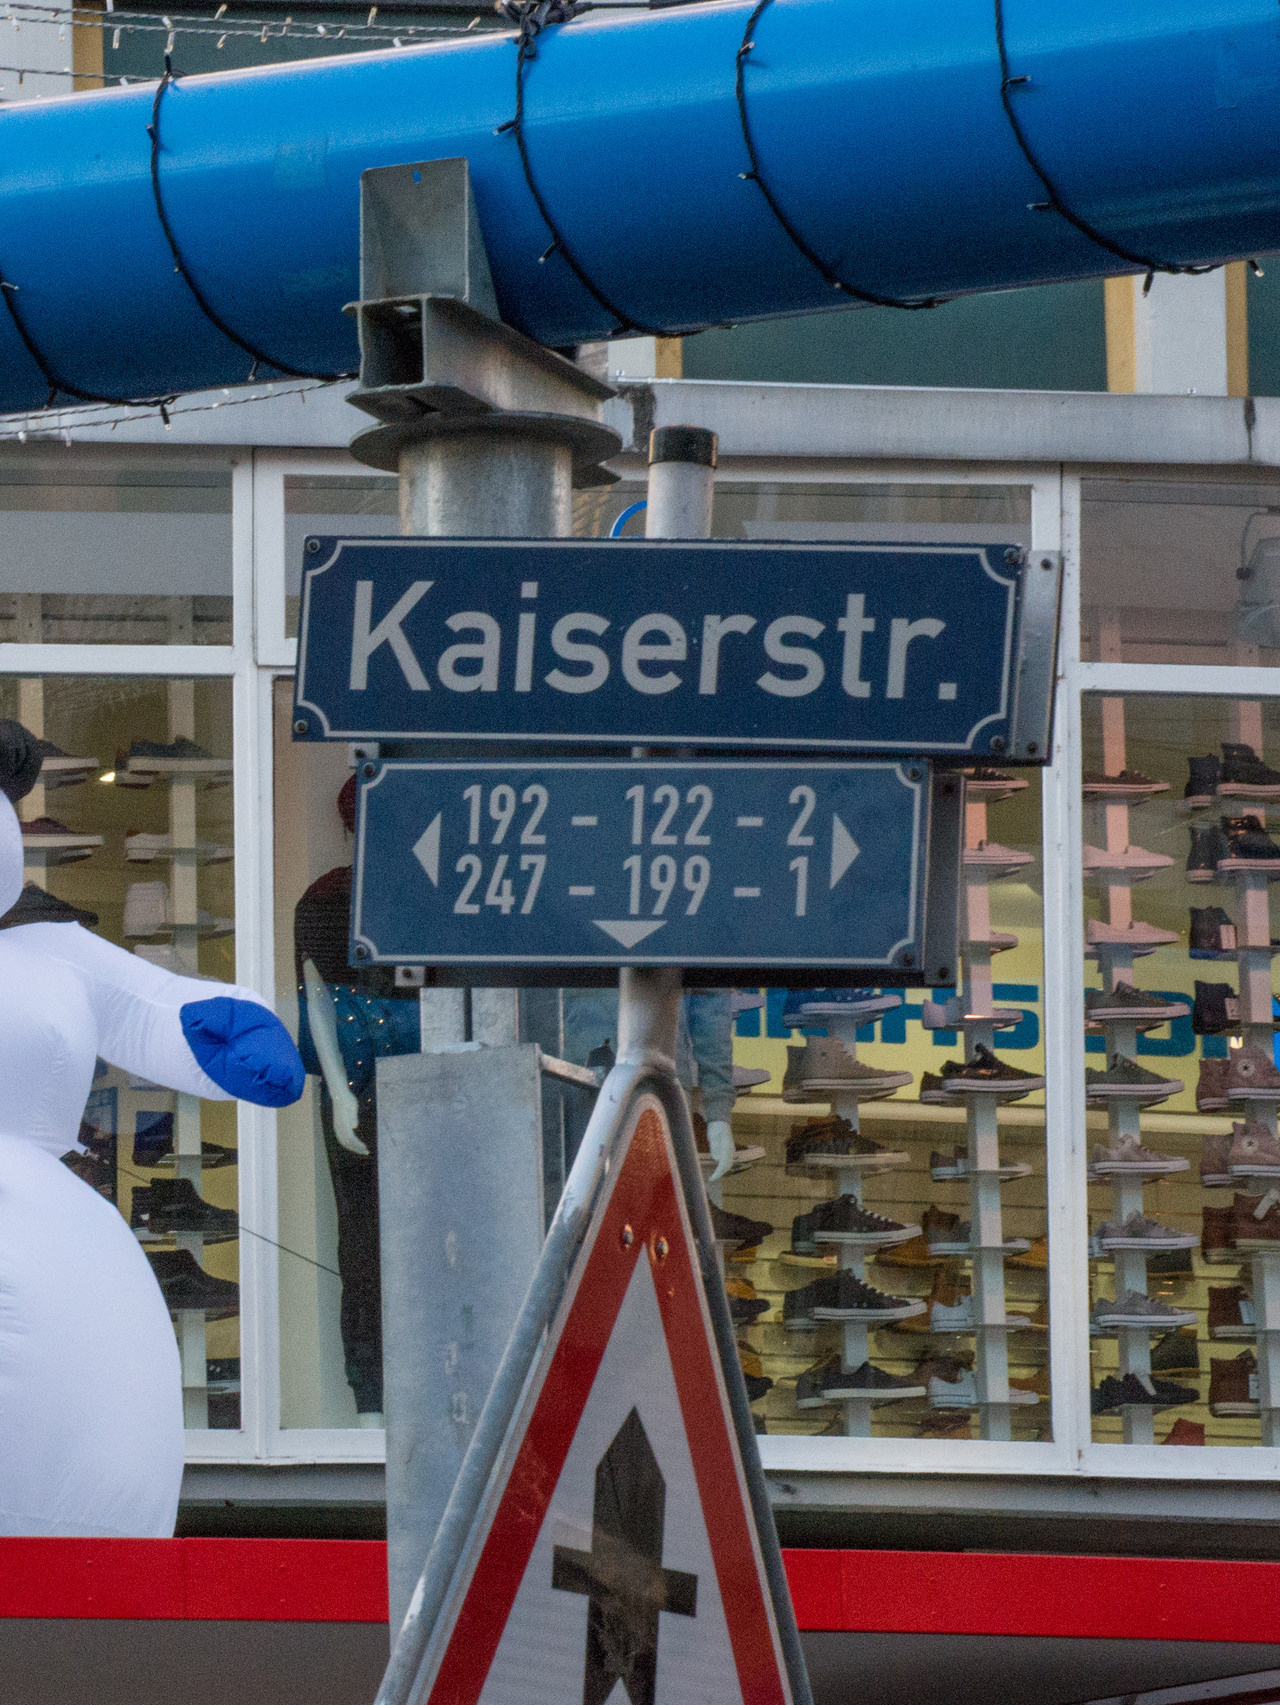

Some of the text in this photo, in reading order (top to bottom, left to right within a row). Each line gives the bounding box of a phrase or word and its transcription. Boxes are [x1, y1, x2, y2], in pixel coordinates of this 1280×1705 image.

[349, 580, 958, 700] Kaiserstr.
[463, 784, 549, 845] 192
[625, 785, 713, 846] 122
[787, 785, 816, 847] 2
[454, 854, 547, 915] 247
[623, 855, 711, 916] 199
[790, 856, 809, 917] 1
